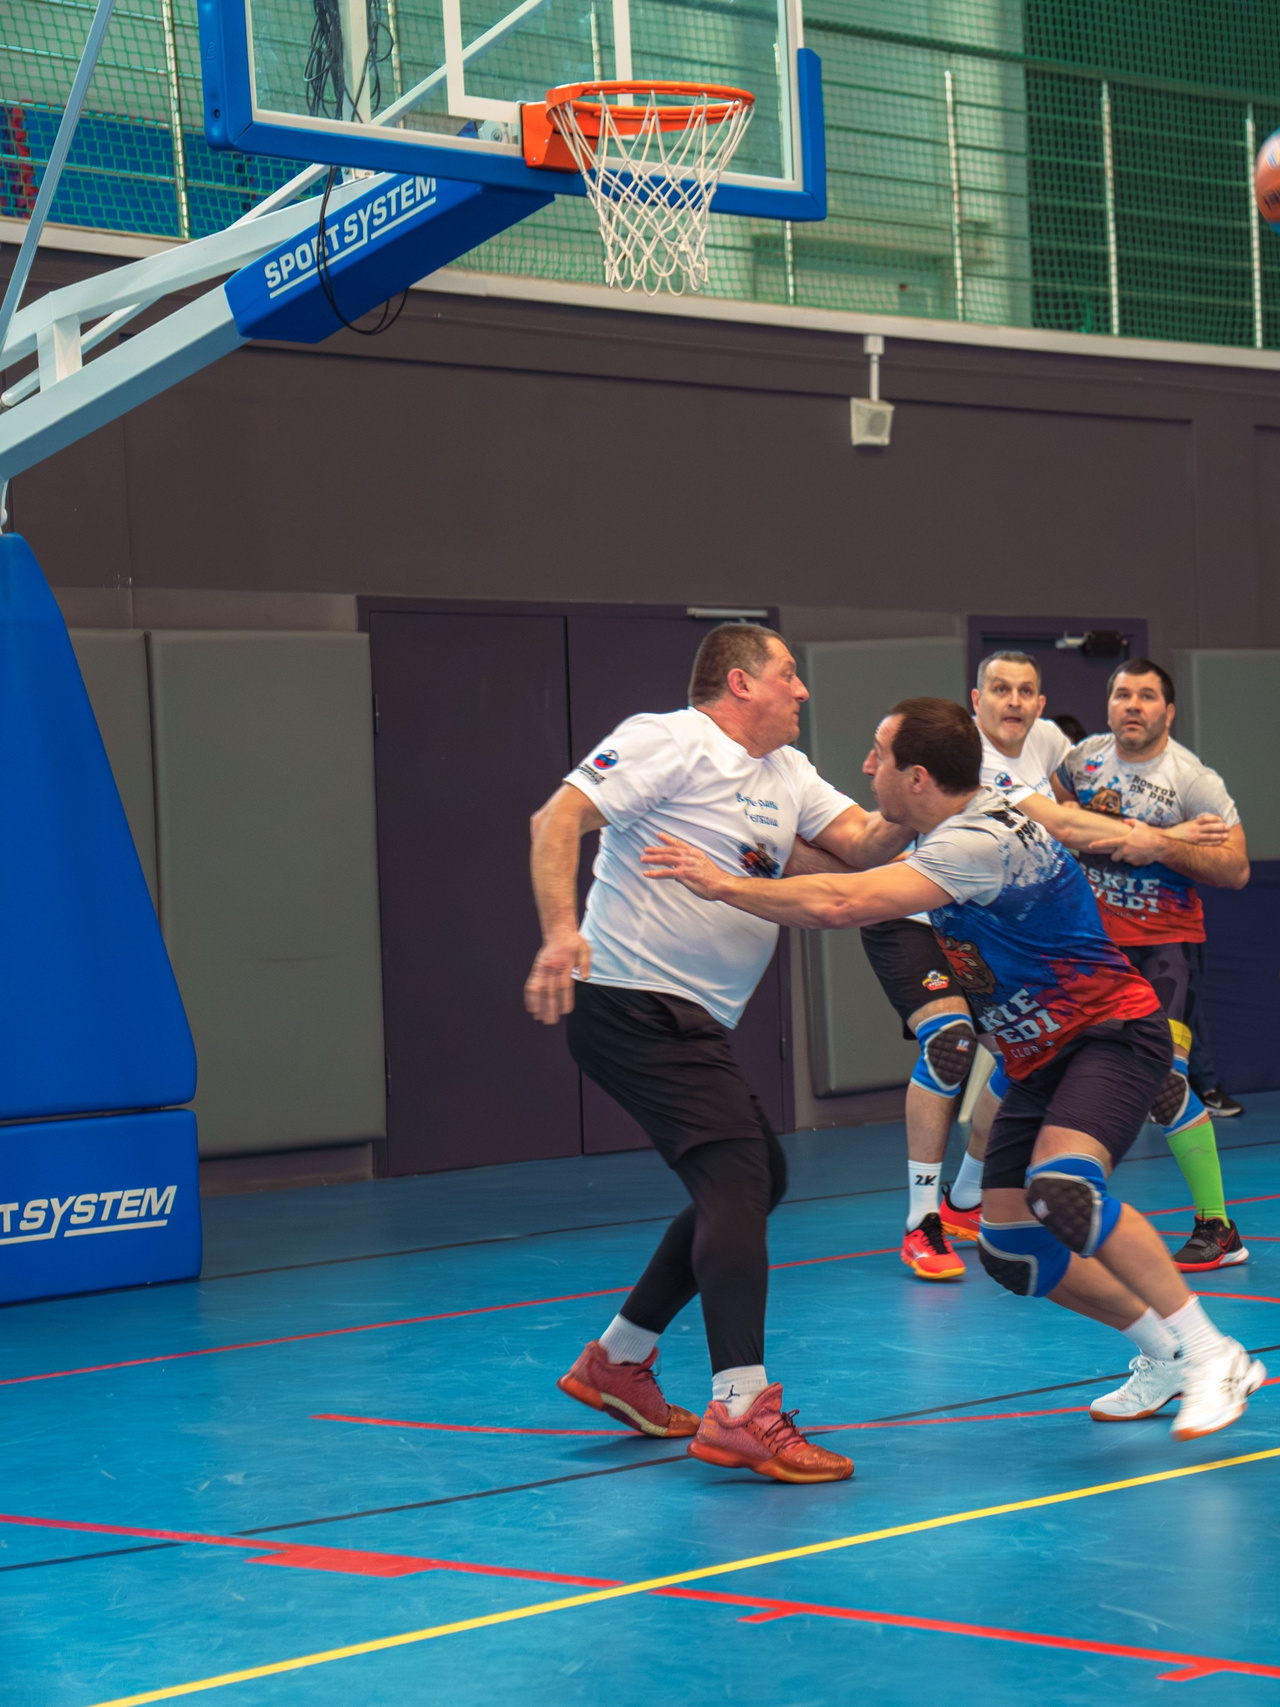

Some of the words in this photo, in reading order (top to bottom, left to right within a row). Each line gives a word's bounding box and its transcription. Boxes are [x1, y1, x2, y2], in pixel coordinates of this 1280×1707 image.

[264, 223, 340, 289] SPORT
[344, 175, 437, 244] SYSTEM
[1129, 784, 1145, 795] ON
[1149, 791, 1175, 807] DON
[1132, 775, 1177, 798] ROSTOV
[991, 1009, 1061, 1044] EDI
[19, 1185, 178, 1239] SYSTEM
